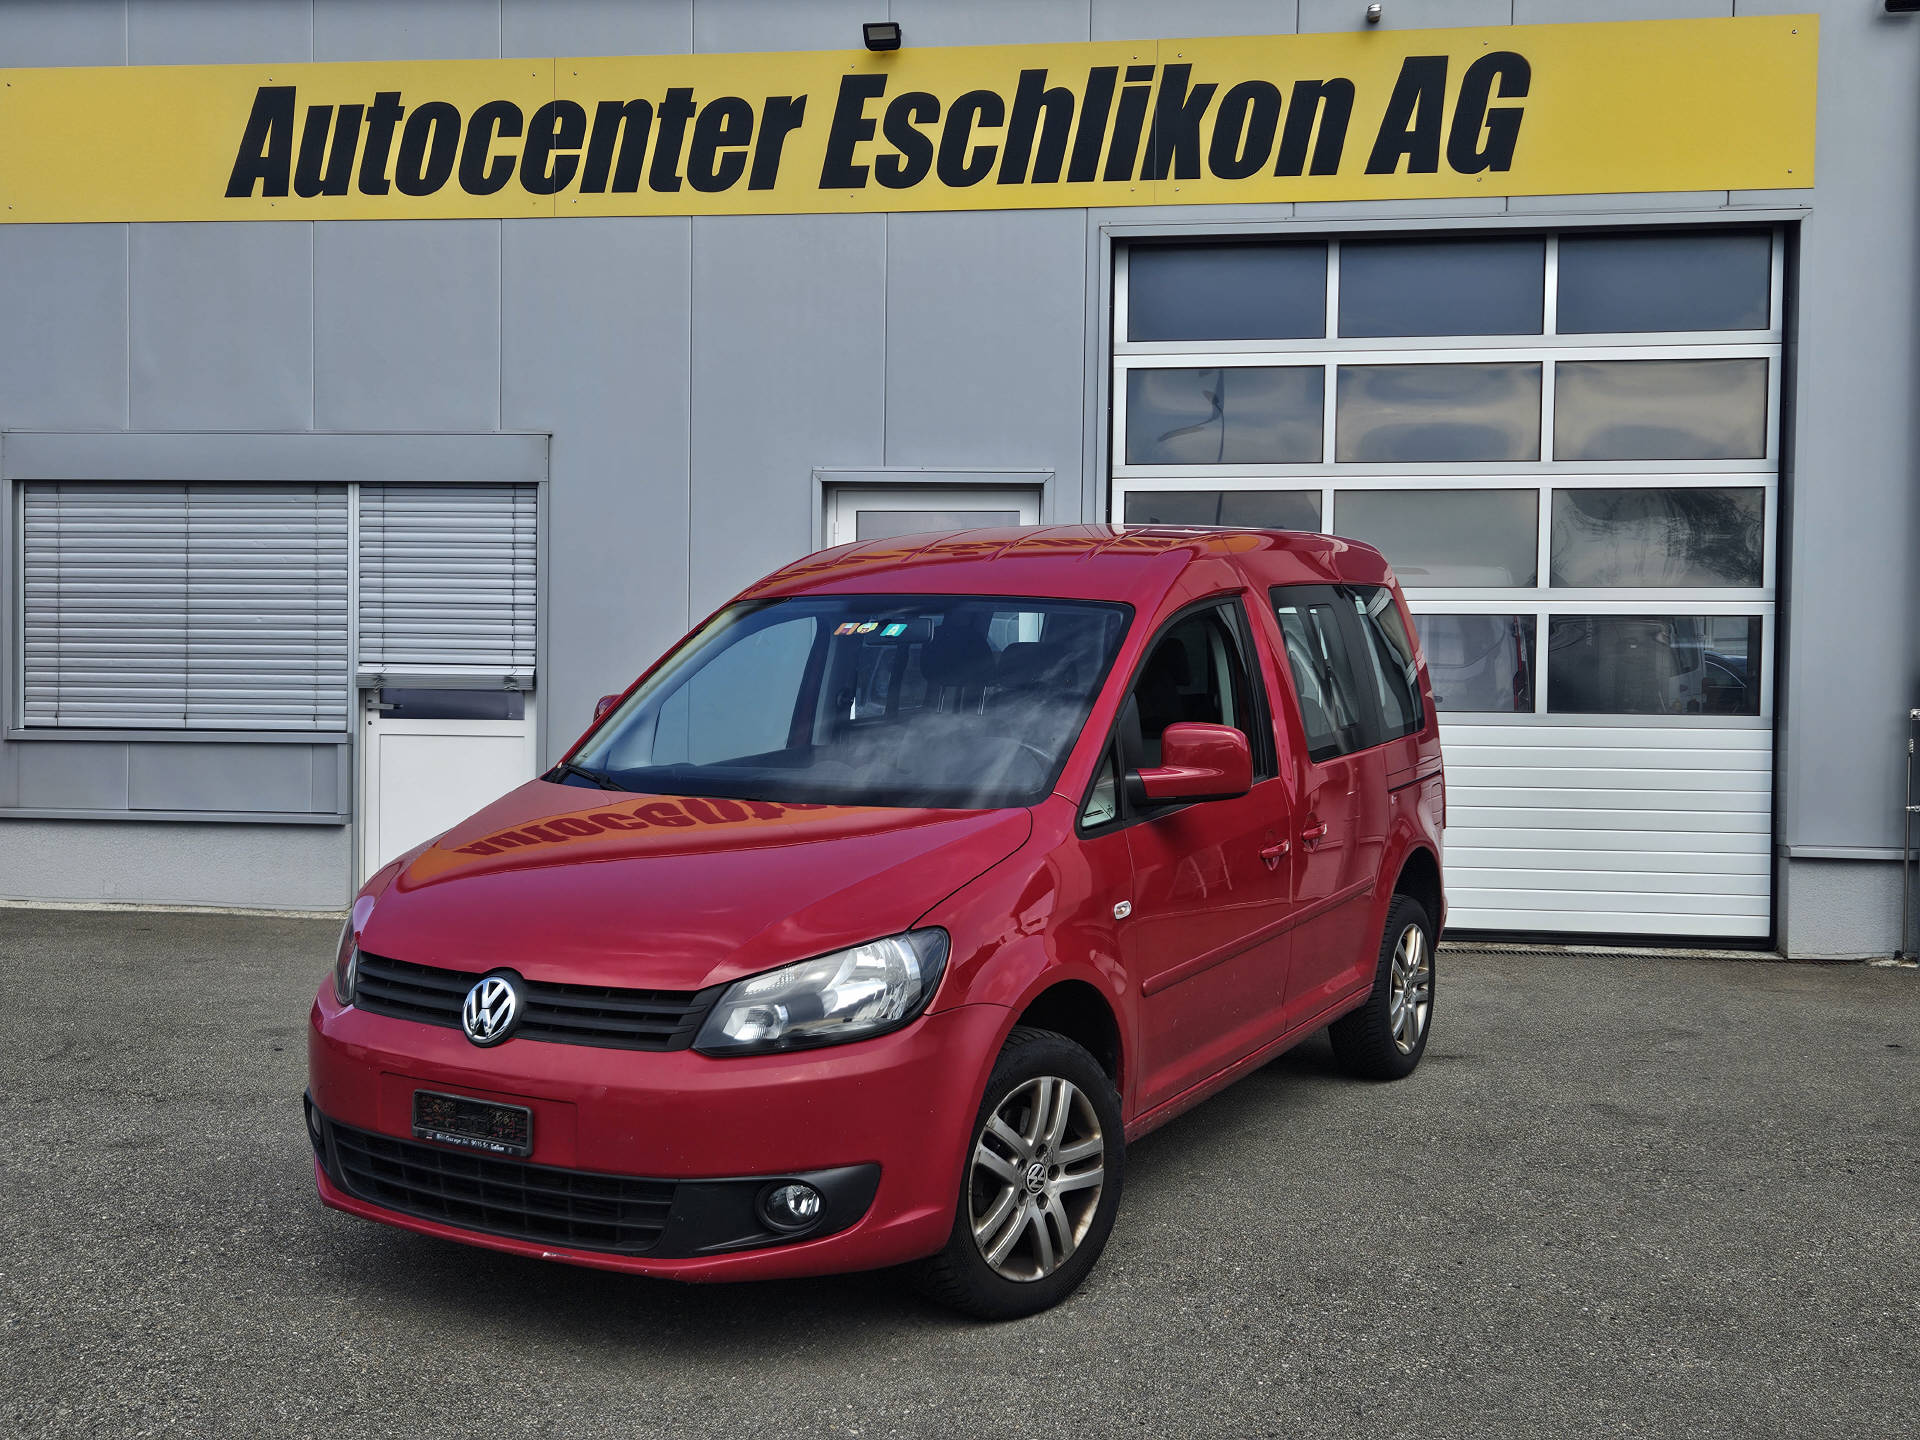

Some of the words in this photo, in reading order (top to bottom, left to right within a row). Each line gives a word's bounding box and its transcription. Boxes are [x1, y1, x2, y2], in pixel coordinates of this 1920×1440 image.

[225, 86, 807, 198] Autocenter
[819, 64, 1355, 190] Eschlikon
[1364, 51, 1532, 175] AG
[464, 977, 516, 1042] VW
